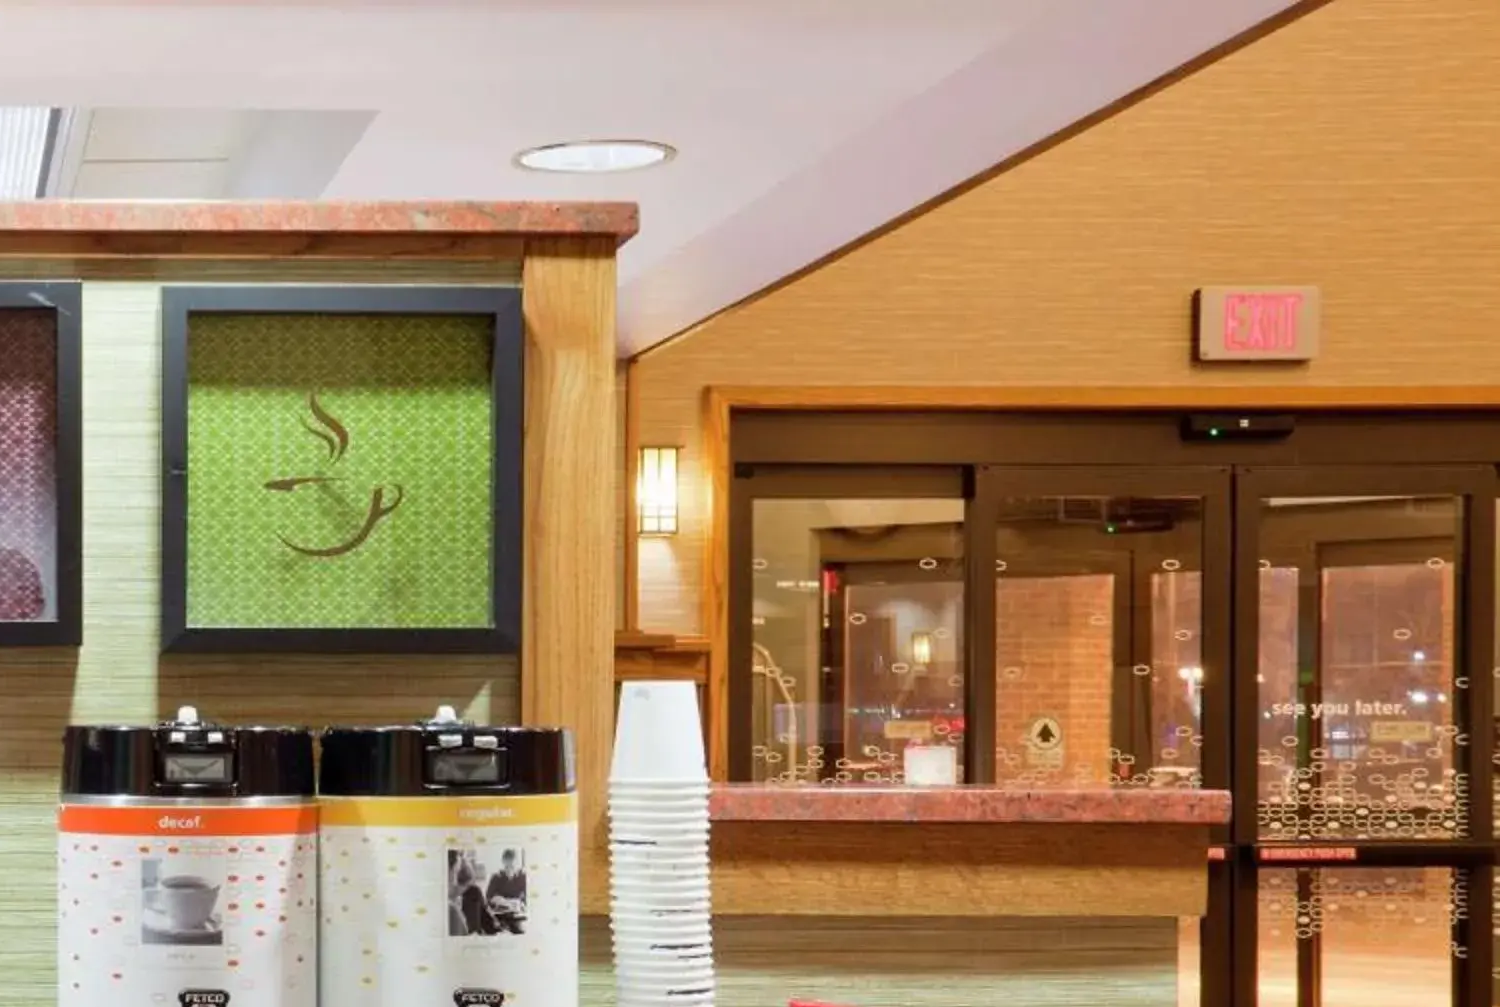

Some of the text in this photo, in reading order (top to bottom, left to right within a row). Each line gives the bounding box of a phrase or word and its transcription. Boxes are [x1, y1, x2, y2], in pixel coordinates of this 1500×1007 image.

[1225, 293, 1303, 350] EXIT
[1271, 699, 1407, 720] see you later.
[158, 814, 206, 830] decaf.
